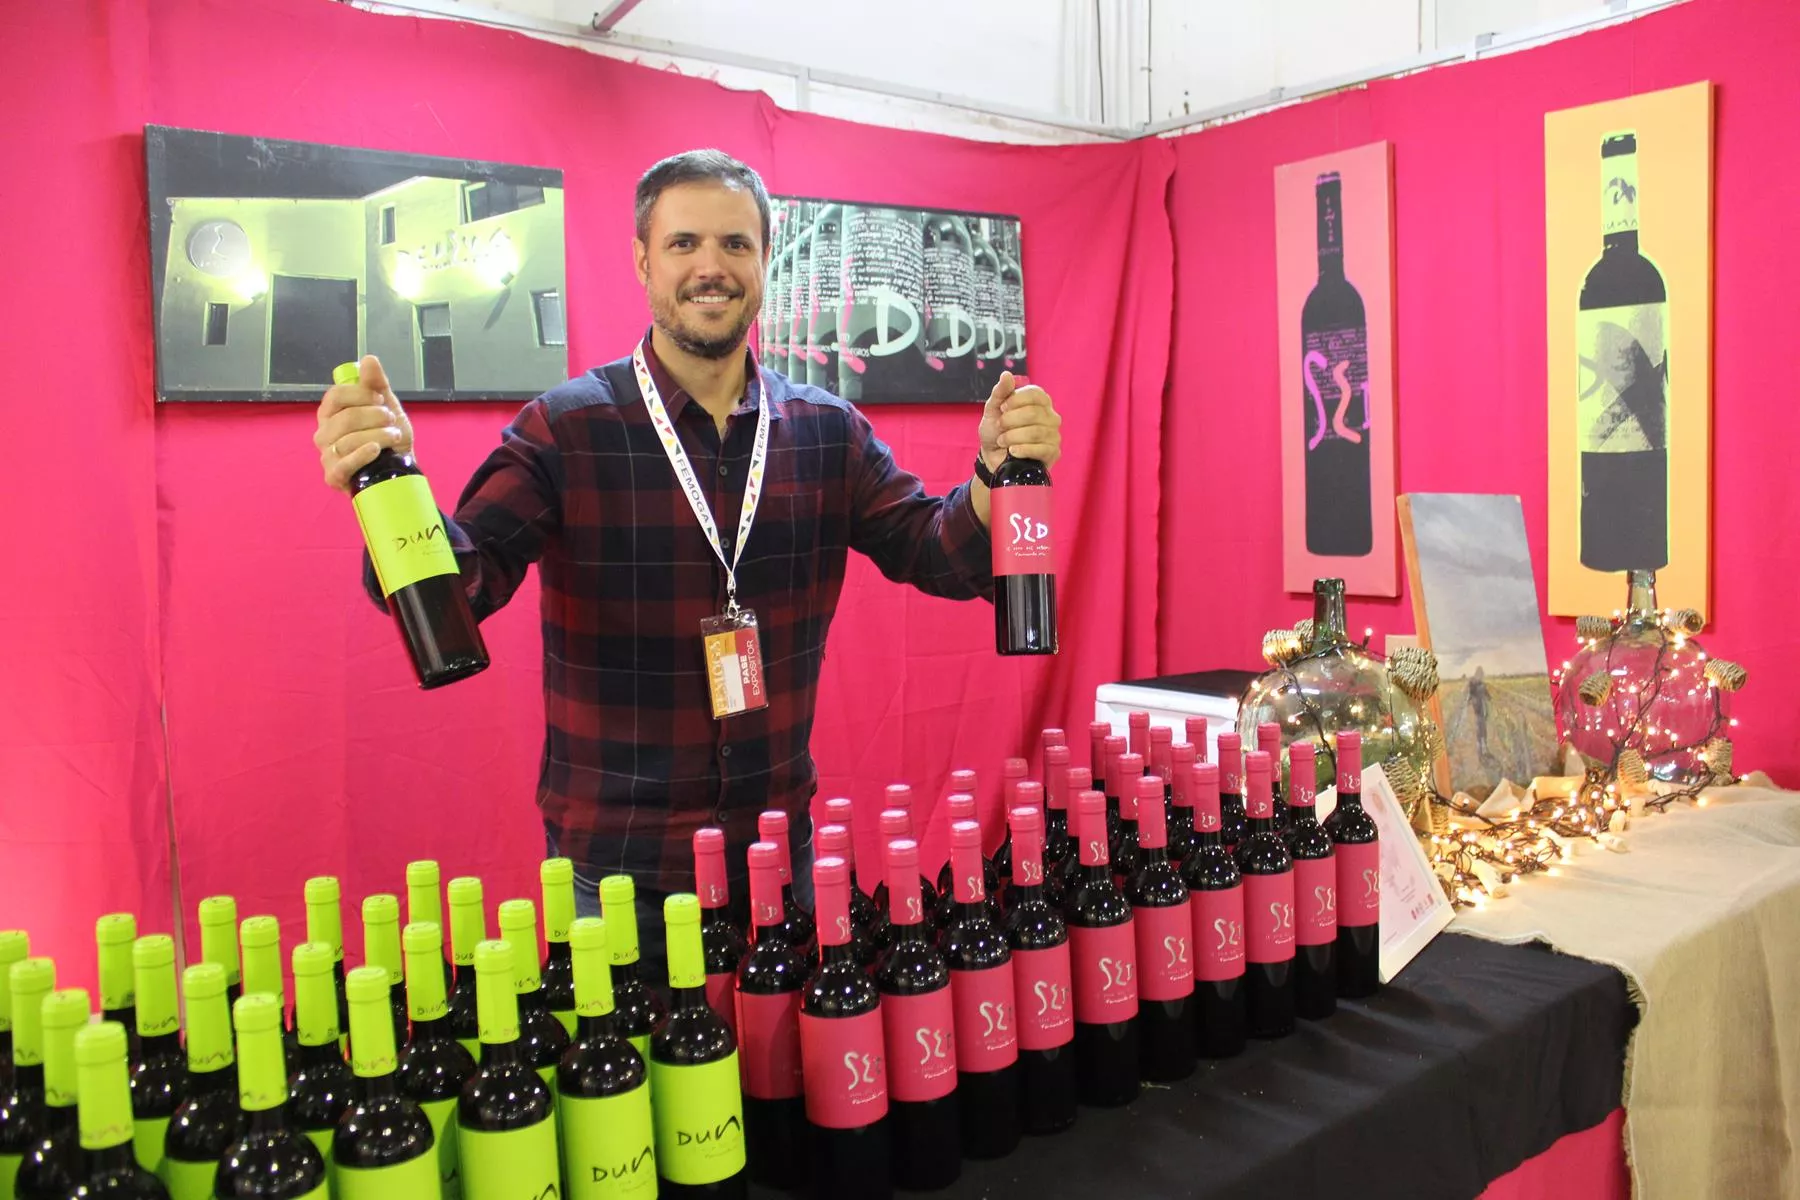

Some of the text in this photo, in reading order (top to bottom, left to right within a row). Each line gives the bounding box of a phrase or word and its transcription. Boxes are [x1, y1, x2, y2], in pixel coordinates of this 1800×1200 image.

[755, 400, 767, 458] FEMOGA
[676, 458, 711, 524] FEMOGA
[1009, 513, 1048, 544] SED
[740, 654, 750, 685] PASE
[746, 639, 761, 696] EXPOSITOR
[1164, 936, 1188, 969] SE
